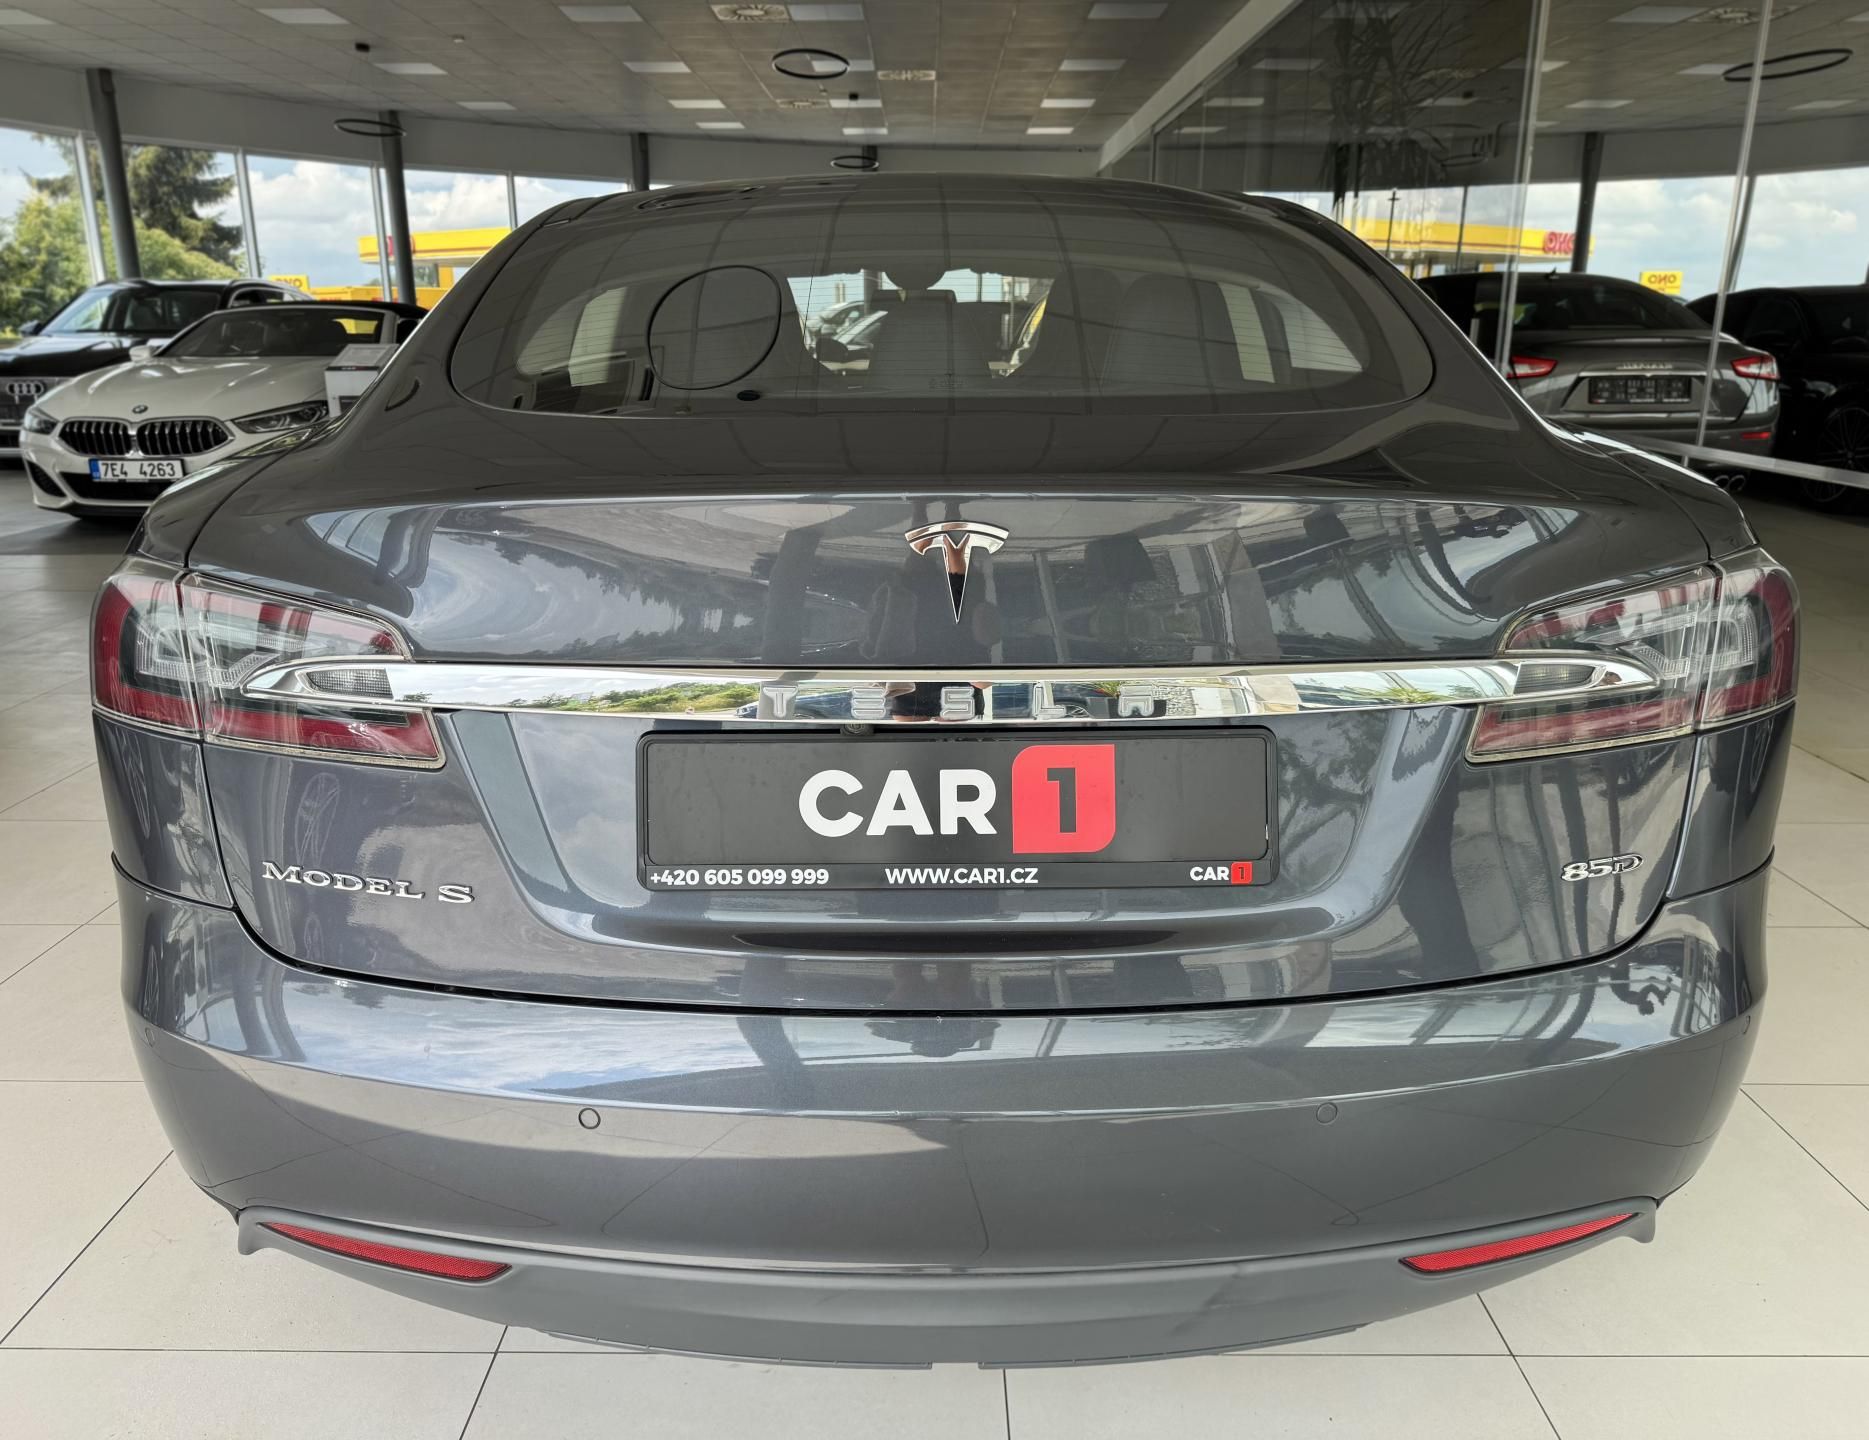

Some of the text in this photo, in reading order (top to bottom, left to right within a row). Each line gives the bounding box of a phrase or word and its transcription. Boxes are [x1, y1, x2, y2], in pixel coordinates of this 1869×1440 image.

[101, 463, 176, 478] 7E4 4263
[762, 683, 1156, 720] TESLA
[650, 868, 829, 886] +420 605 099 999
[885, 867, 1039, 885] WWW.CAR1.CZ
[1561, 853, 1644, 881] 85D
[262, 861, 475, 904] MODEL S
